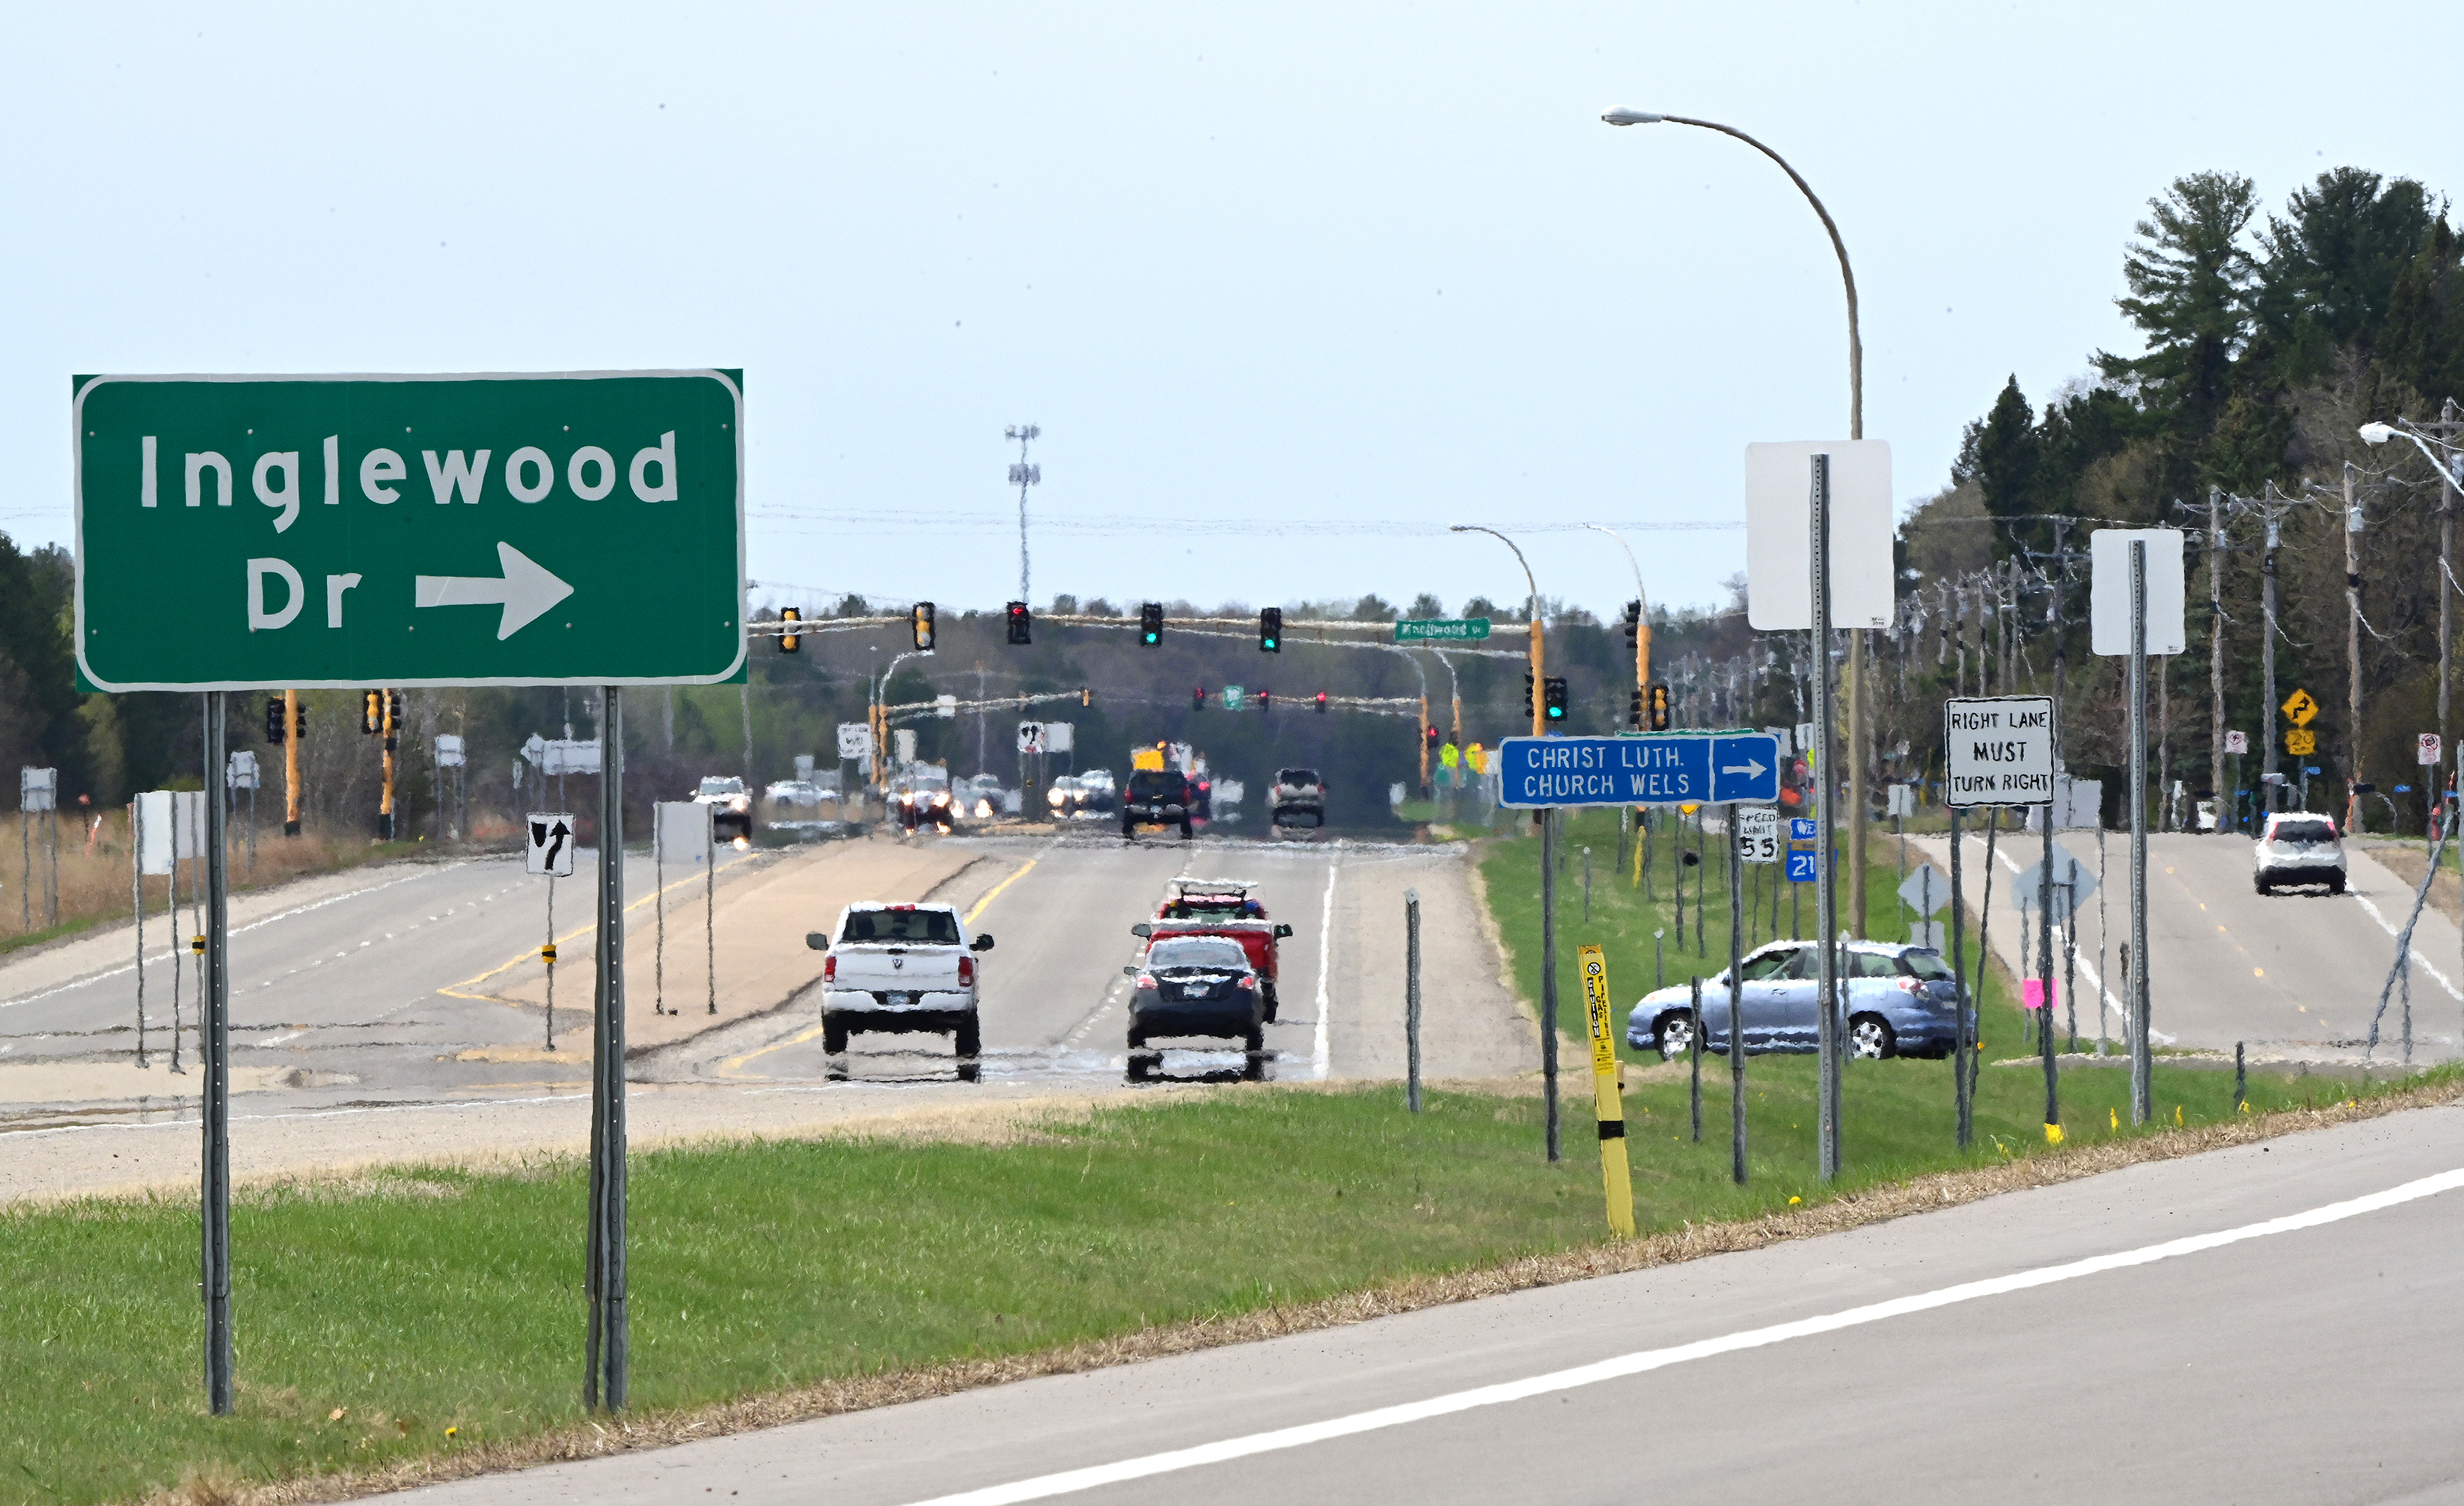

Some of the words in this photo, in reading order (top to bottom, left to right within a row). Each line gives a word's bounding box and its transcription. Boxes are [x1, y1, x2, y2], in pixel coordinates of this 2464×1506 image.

[141, 429, 679, 534] Inglewood
[247, 557, 363, 631] Dr
[1951, 712, 1999, 730] RIGHT
[2009, 711, 2048, 729] LANE
[1527, 746, 1607, 769] CHRIST
[1621, 746, 1684, 768] LUTH.
[1973, 741, 2027, 762] MUST
[1524, 774, 1615, 798] CHURCH
[1630, 773, 1690, 796] WELS
[1953, 775, 1996, 792] TURN
[2002, 774, 2049, 792] RIGHT
[1739, 812, 1776, 823] SPEED
[1743, 824, 1772, 836] LIMIT
[1740, 836, 1775, 858] 55
[1792, 855, 1815, 877] 21
[1588, 979, 1600, 1036] CAUTION
